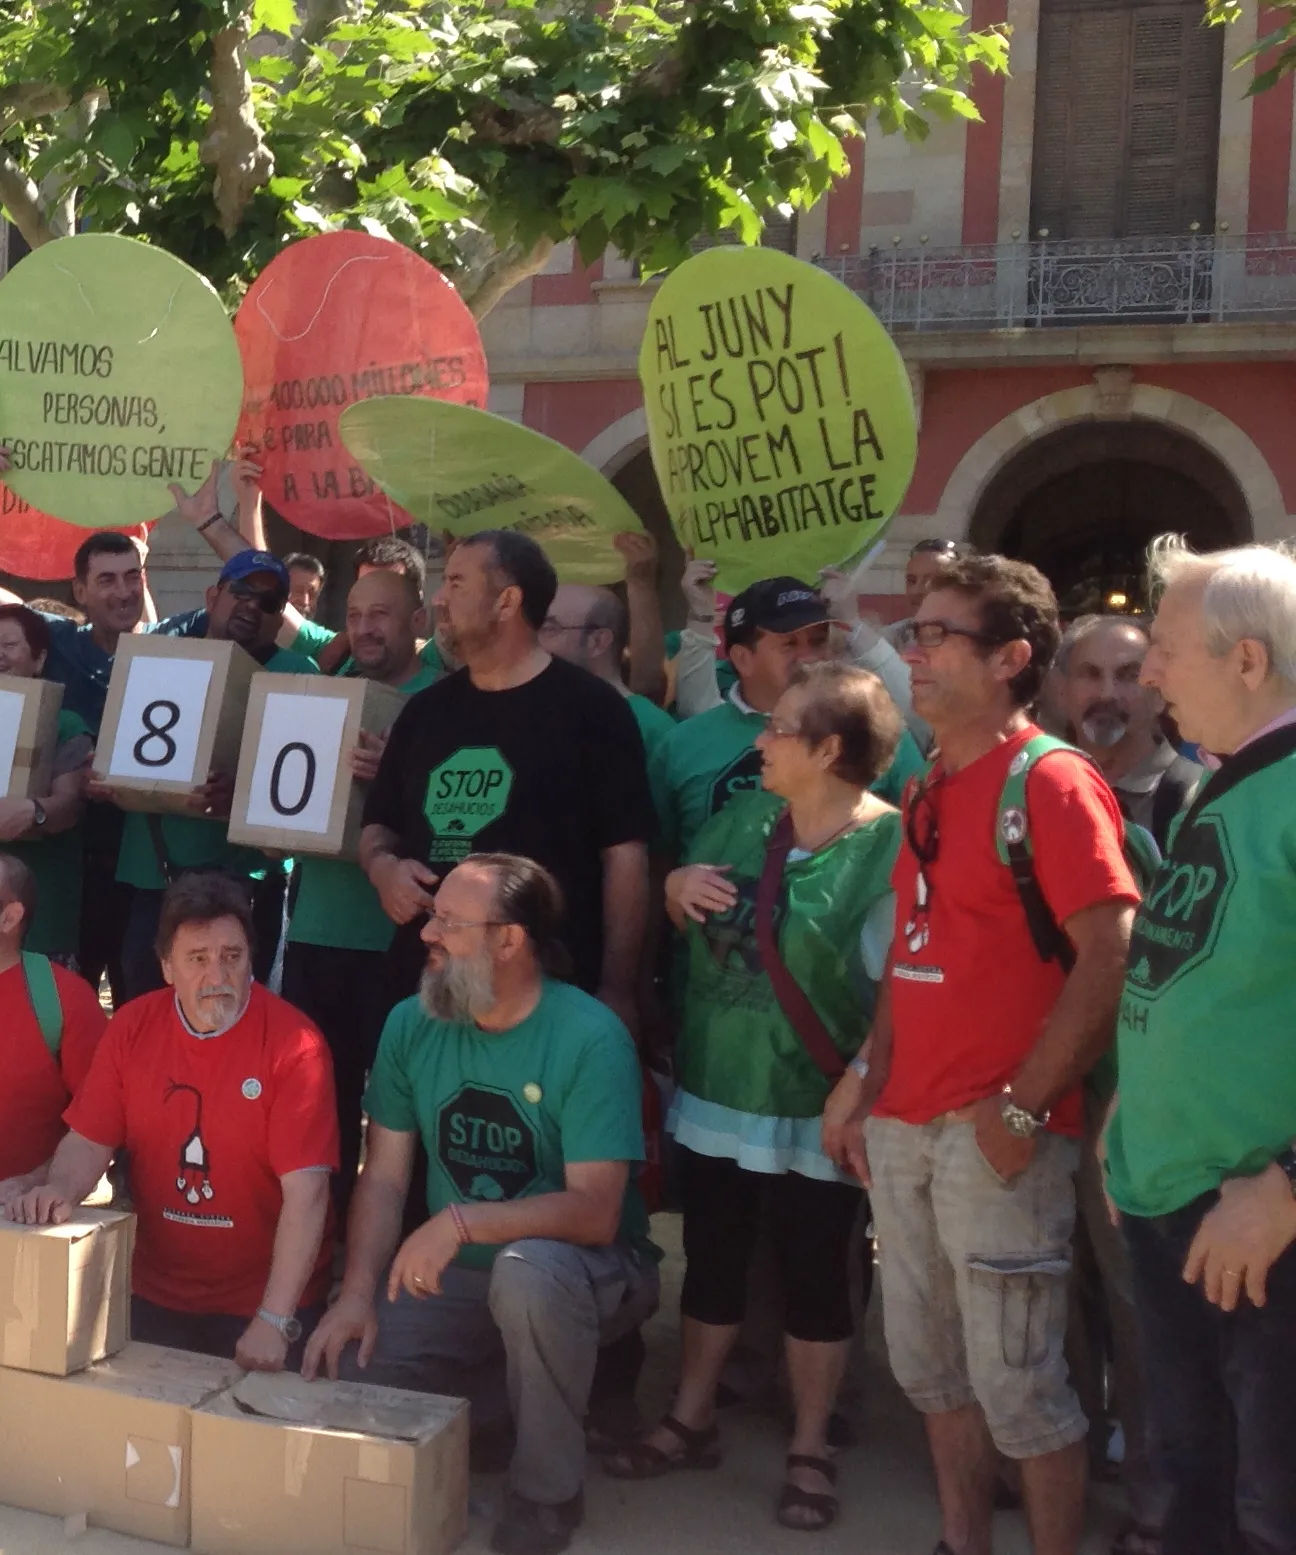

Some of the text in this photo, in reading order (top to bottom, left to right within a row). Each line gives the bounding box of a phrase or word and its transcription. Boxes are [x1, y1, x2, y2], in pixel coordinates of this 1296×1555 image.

[656, 284, 793, 373] AL JUNY
[43, 392, 166, 435] PERSONAS,
[688, 368, 736, 432] ES
[132, 446, 208, 480] GENTE
[668, 408, 884, 494] APROVEM LA
[283, 472, 299, 501] A
[133, 699, 181, 767] 8
[269, 742, 316, 816] 0
[436, 769, 503, 799] STOP
[1121, 1002, 1149, 1034] AH
[449, 1112, 522, 1155] STOP
